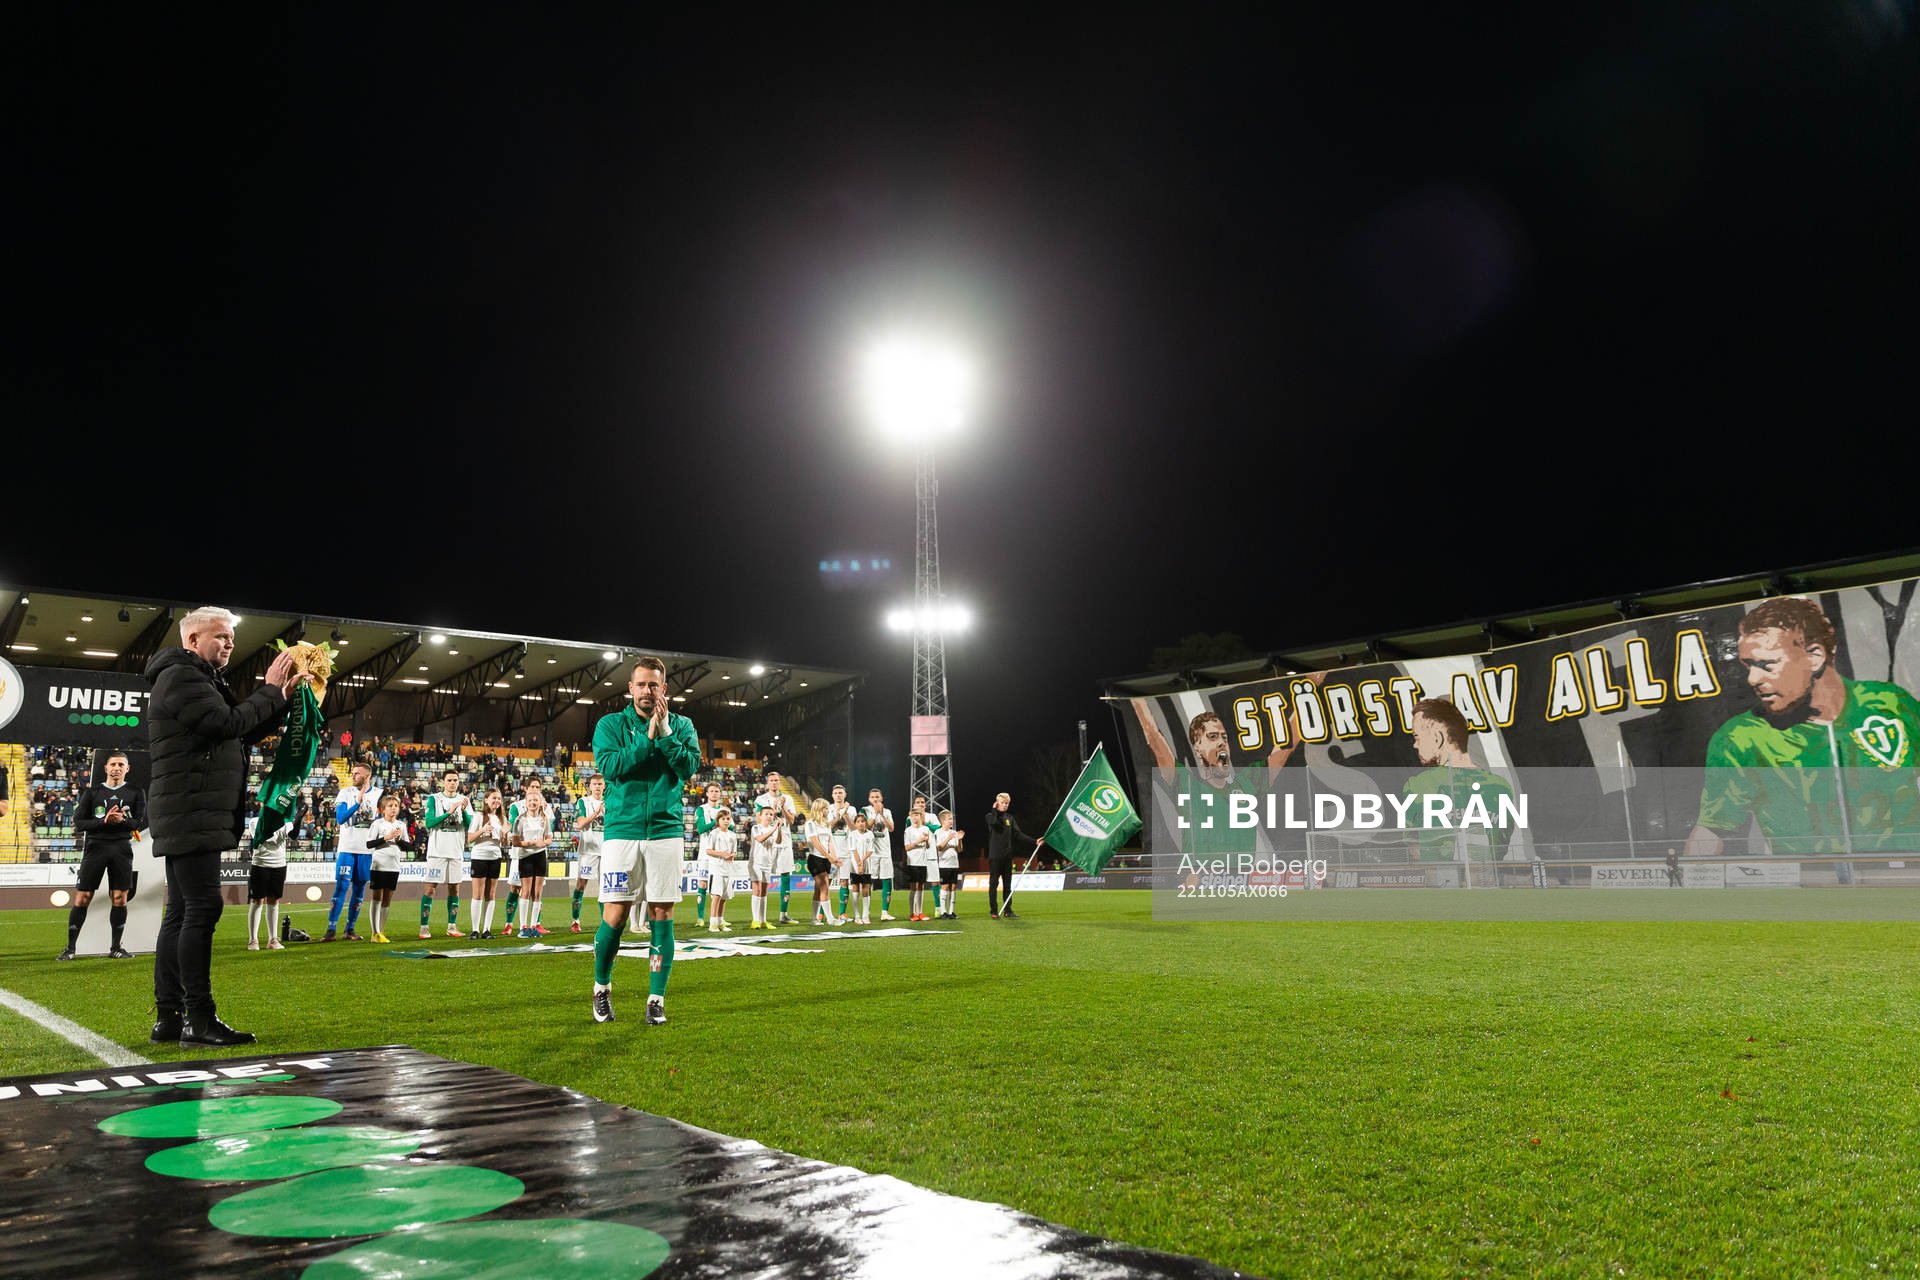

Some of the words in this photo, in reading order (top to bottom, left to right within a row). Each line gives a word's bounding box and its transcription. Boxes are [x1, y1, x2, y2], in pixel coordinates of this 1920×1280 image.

[1234, 678, 1421, 750] STÖRST
[1451, 664, 1517, 738] AV
[1546, 629, 1721, 721] ALLA
[1076, 801, 1111, 829] SUPERETTAN
